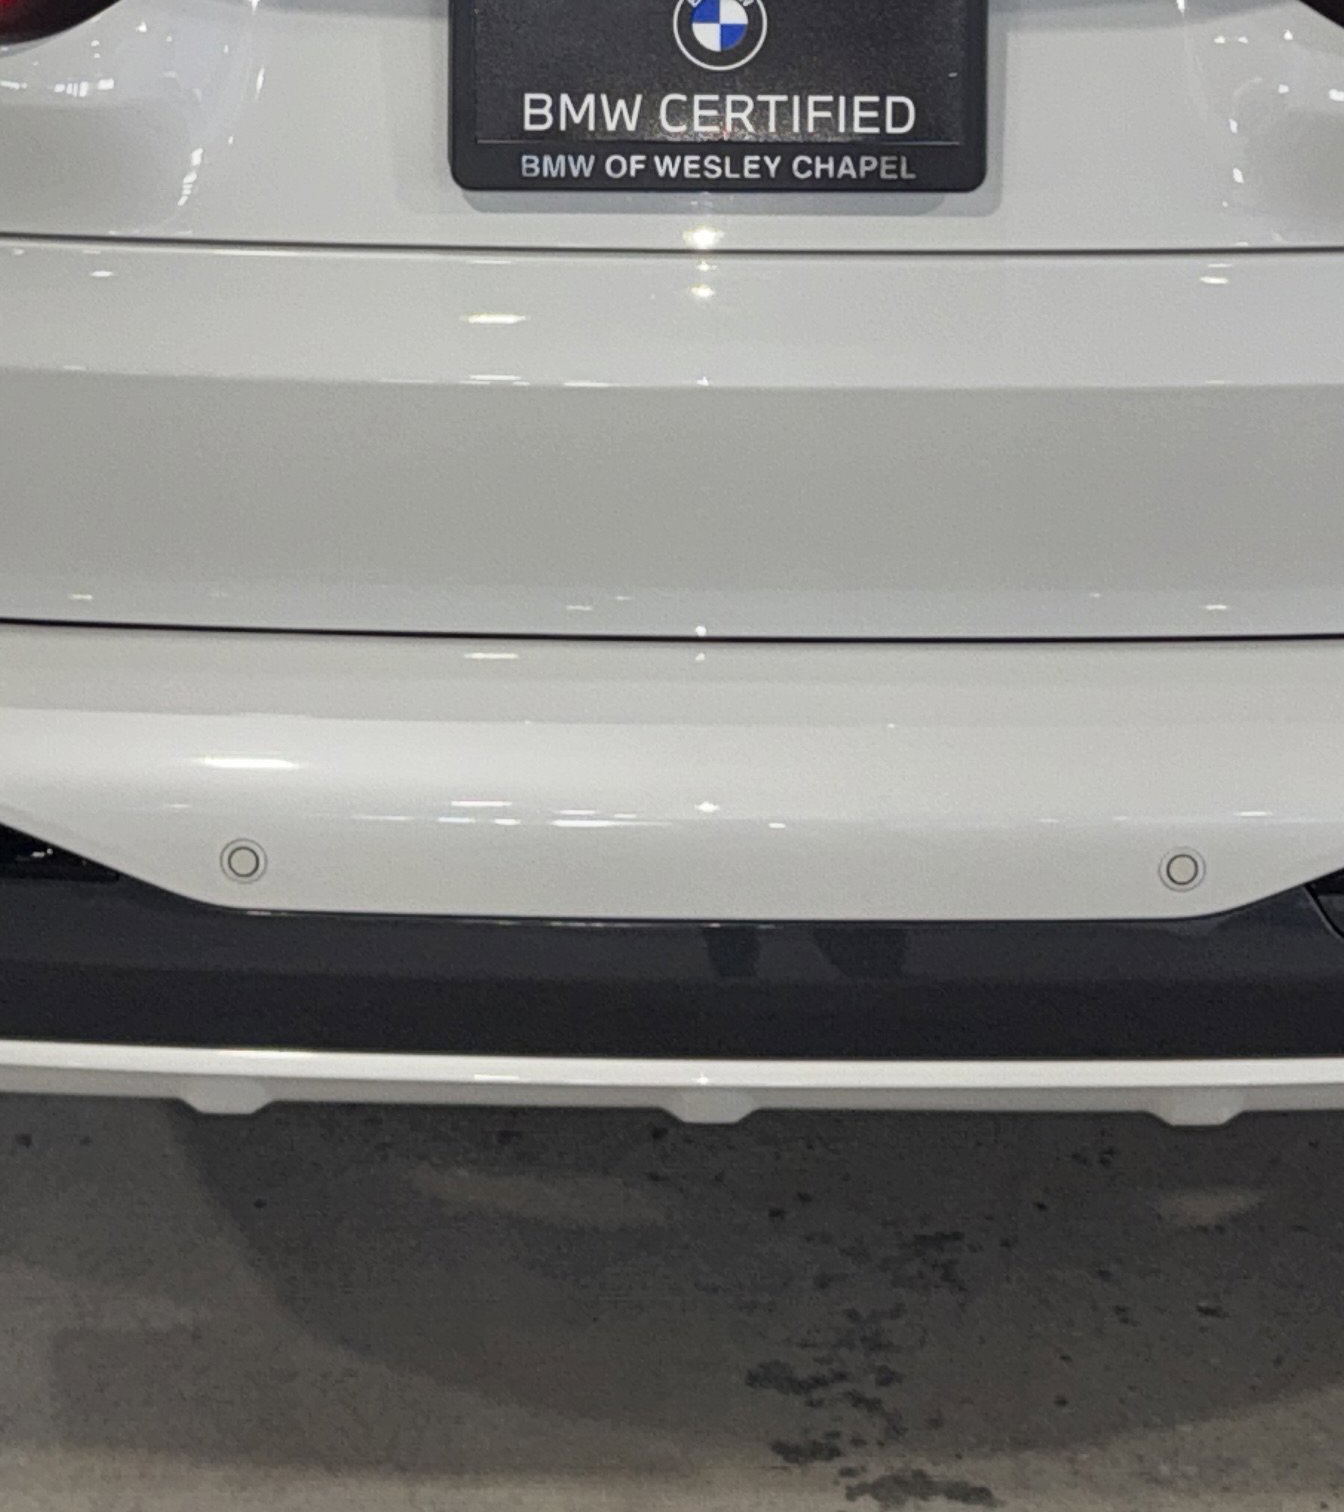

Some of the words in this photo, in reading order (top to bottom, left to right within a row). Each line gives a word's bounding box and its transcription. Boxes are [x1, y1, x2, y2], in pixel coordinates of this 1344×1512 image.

[524, 93, 642, 131] BMW
[659, 94, 915, 134] CERTIFIED
[522, 154, 595, 177] BMW
[605, 155, 646, 178] OF
[654, 155, 781, 178] WESLEY
[792, 155, 916, 179] CHAPEL
